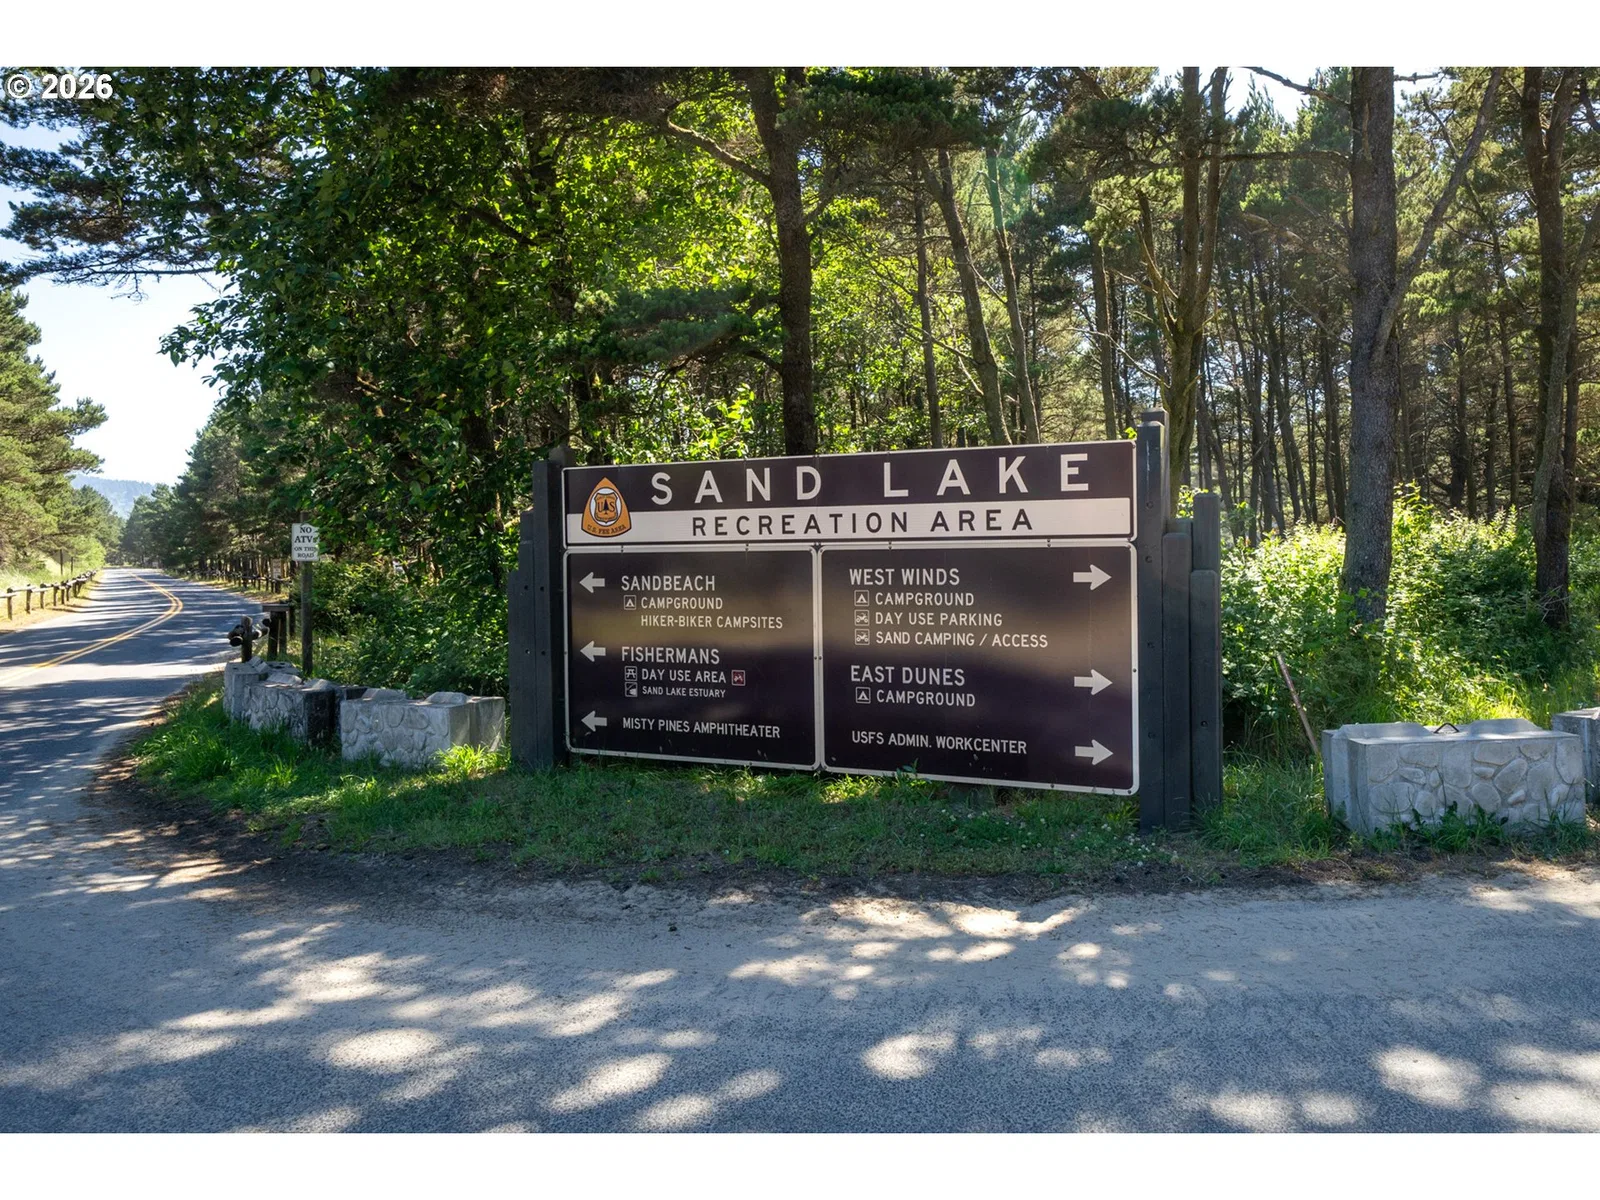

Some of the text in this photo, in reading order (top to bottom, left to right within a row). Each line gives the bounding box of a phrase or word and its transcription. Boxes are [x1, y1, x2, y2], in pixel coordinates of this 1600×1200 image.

[651, 453, 1089, 505] SAND LAKE
[692, 508, 1033, 536] RECREATION AREA
[621, 575, 716, 591] SANDBEACH
[849, 568, 960, 586] WEST WINDS
[640, 597, 723, 610] CAMPGROUND
[875, 592, 975, 607] CAMPGROUND
[640, 615, 783, 629] HIKER-BIKER CAMPSITES
[875, 612, 1003, 627] DAY USE PARKING
[876, 631, 1048, 648] SAND CAMPING / ACCESS
[621, 646, 720, 665] FISHERMANS
[641, 668, 727, 684] DAY USE AREA
[850, 665, 966, 687] EAST DUNES
[642, 686, 726, 698] SAND LAKE ESTUARY
[876, 689, 976, 708] CAMPGROUND
[622, 717, 781, 739] MISTY PINES AMPHITHEATER
[852, 730, 1027, 755] USFS ADMIN. WORKCENTER
